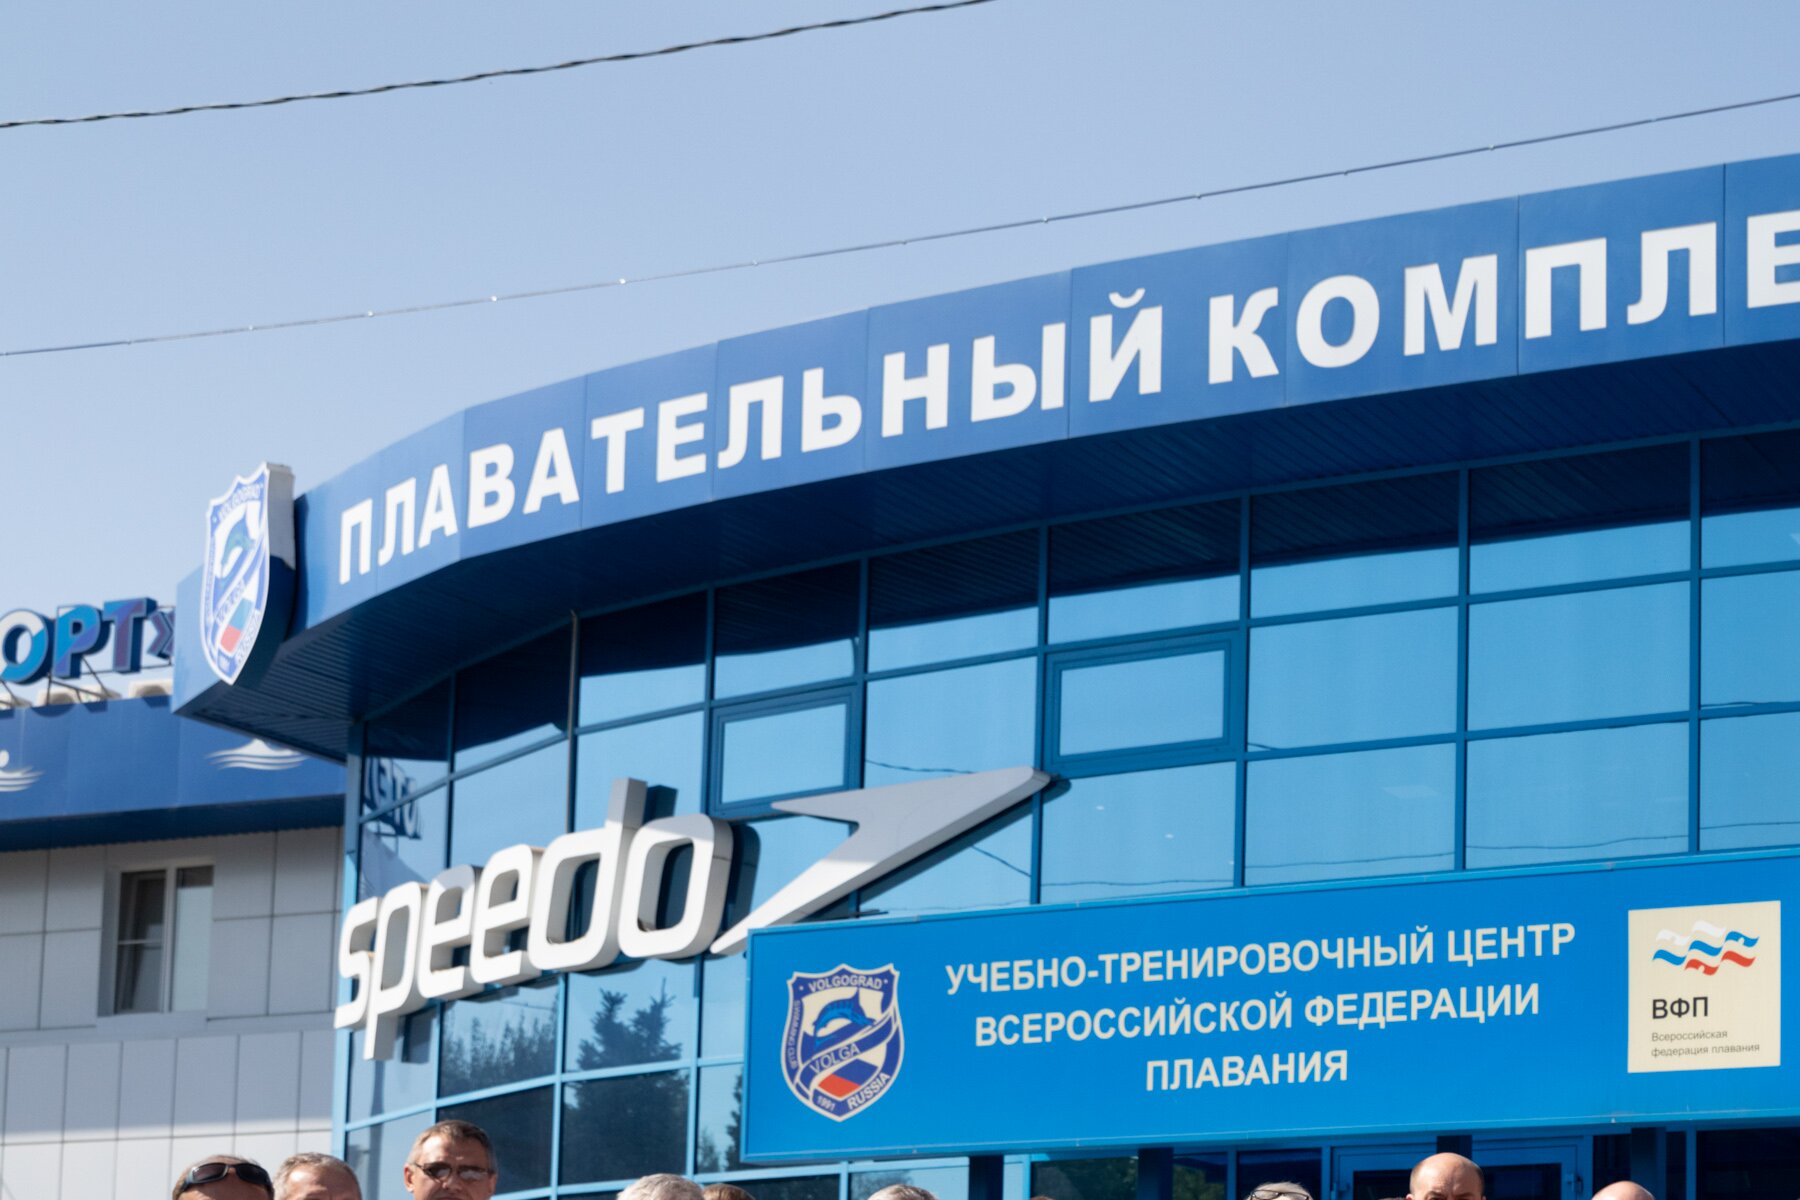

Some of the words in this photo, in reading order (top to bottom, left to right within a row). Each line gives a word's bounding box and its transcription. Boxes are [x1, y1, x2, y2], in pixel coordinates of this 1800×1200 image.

[339, 287, 1163, 585] ПЛАВАТЕЛЬНЫЙ
[334, 777, 734, 1062] speedo
[946, 926, 1434, 996] УЧЕБНО-ТРЕНИРОВОЧНЫЙ
[1450, 922, 1576, 965] ЦЕНТР
[808, 974, 882, 993] VOLGOGRAD
[975, 988, 1294, 1048] ВСЕРОССИЙСКОЙ
[1304, 981, 1540, 1032] ФЕДЕРАЦИИ
[1652, 996, 1708, 1020] ВФП
[1651, 1029, 1727, 1042] Всероссийская
[1651, 1045, 1709, 1057] федерация
[1711, 1043, 1760, 1054] плавания
[810, 1043, 860, 1074] VOLGA
[1145, 1048, 1349, 1092] ПЛАВАНИЯ
[847, 1072, 890, 1110] RUSSIA
